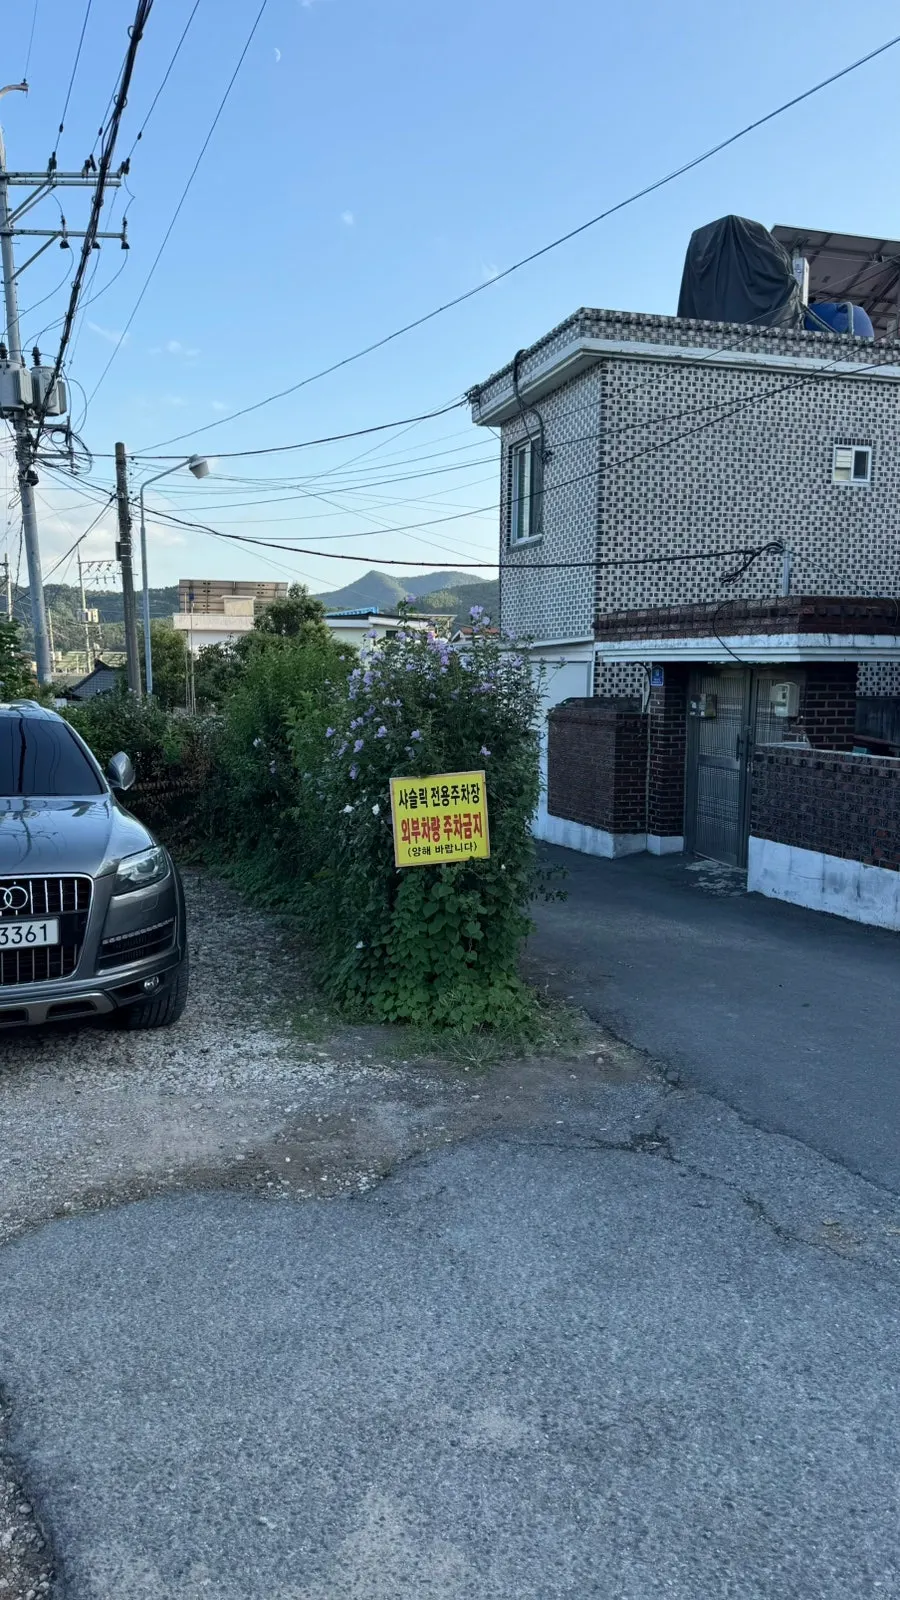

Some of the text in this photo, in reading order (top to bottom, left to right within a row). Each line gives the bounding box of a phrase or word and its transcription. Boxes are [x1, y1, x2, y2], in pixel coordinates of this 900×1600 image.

[399, 782, 480, 810] 샤슬릭 전용주차장
[401, 812, 483, 844] 외부차량 주차금지
[407, 841, 478, 857] (양해 바랍니다)
[0, 923, 47, 945] 3361
